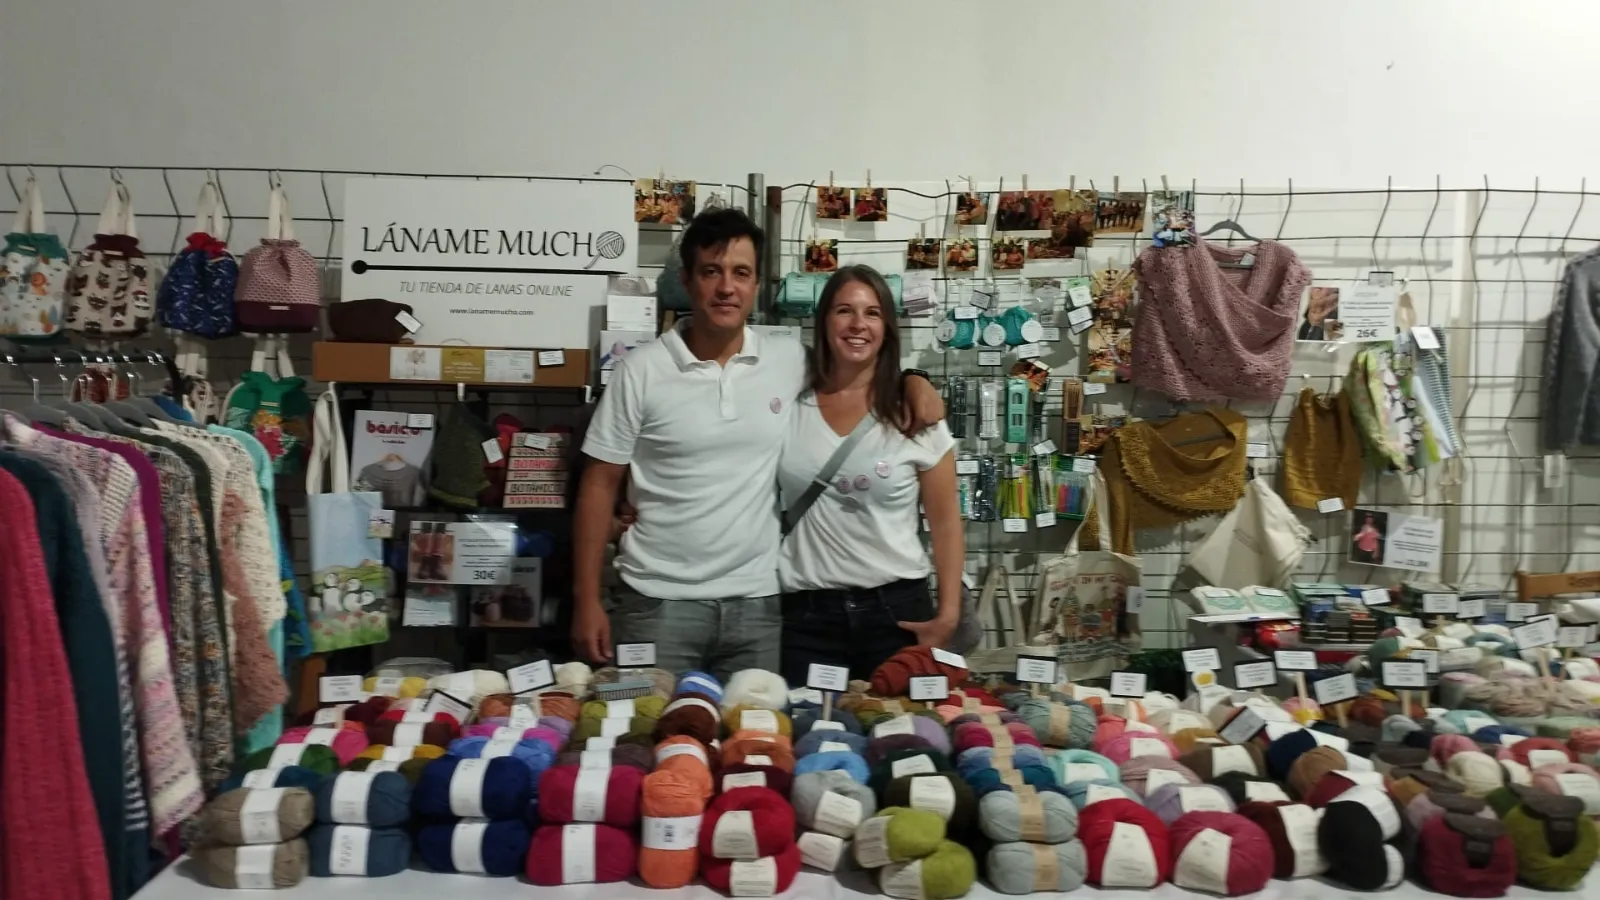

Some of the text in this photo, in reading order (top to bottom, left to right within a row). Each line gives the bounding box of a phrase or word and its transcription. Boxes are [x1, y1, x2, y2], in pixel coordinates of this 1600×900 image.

[361, 222, 489, 254] LÁNAME
[400, 281, 573, 297] TU TIENDA DE LANAS ONLINE
[473, 570, 496, 580] 30€
